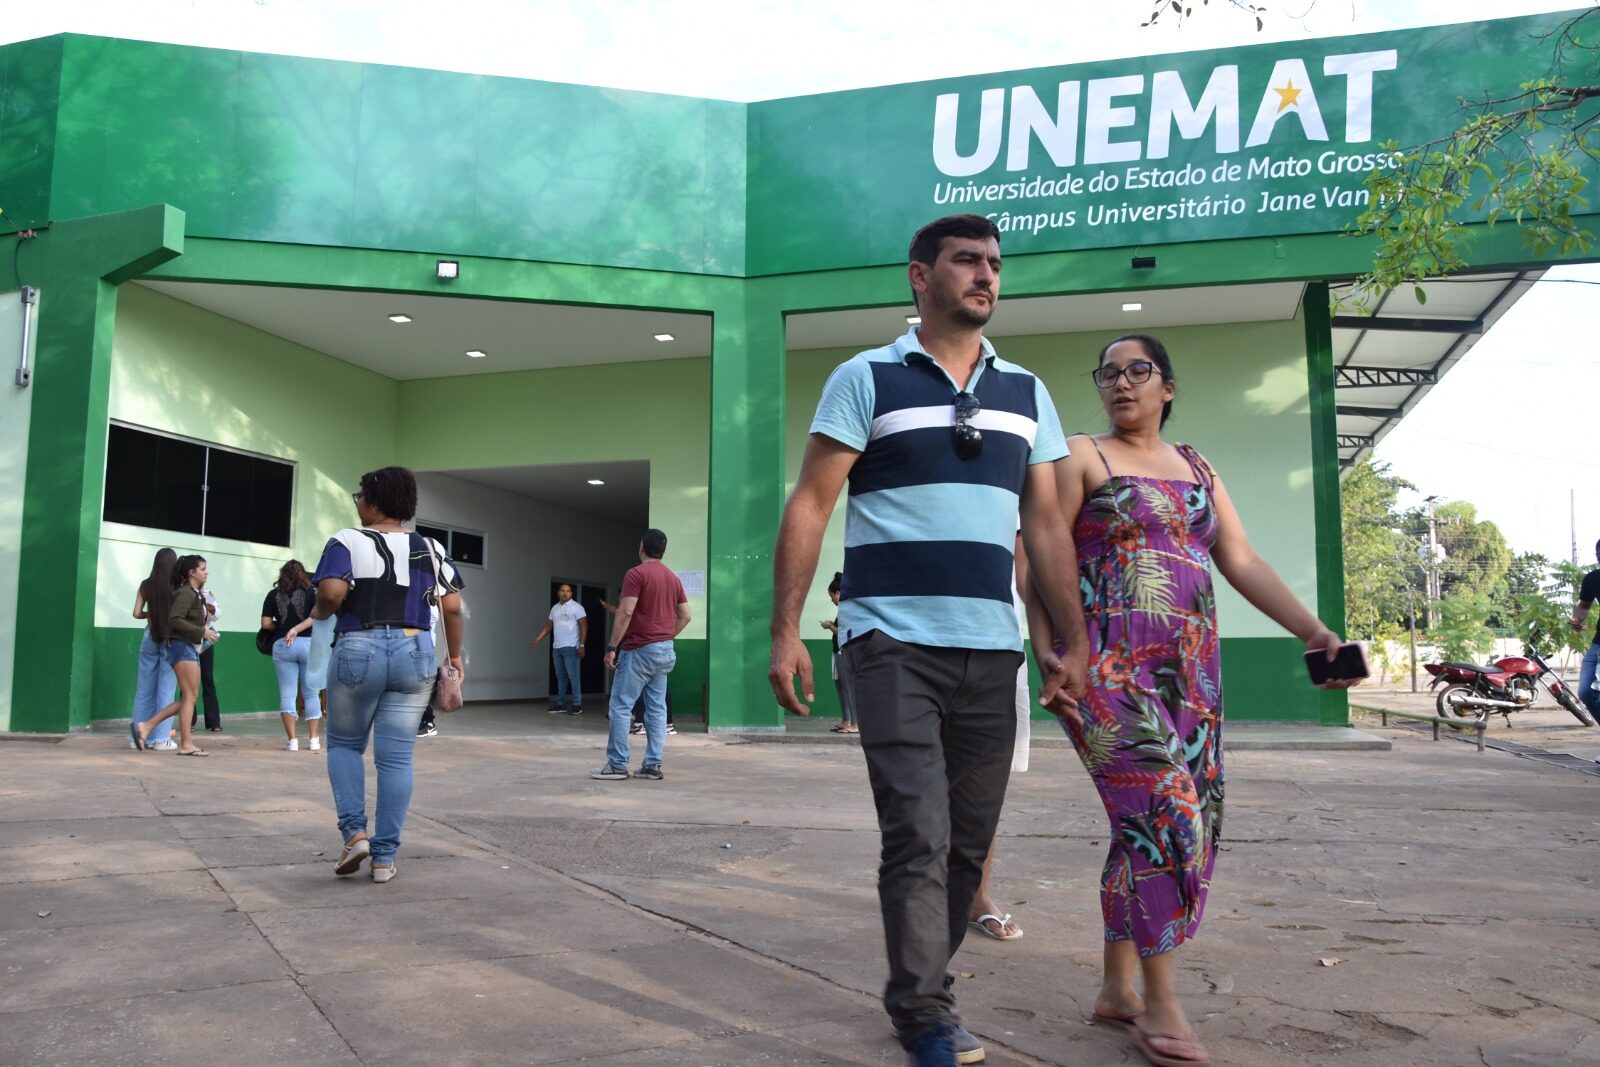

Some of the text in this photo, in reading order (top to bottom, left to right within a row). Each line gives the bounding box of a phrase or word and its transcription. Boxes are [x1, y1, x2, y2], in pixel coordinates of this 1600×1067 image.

[932, 48, 1399, 179] UNEMAT
[933, 174, 1085, 206] Universidade
[1088, 169, 1120, 193] do
[1123, 162, 1207, 190] Estado
[1211, 159, 1242, 183] de
[1246, 154, 1312, 182] Mato
[1086, 195, 1247, 226] Universitário
[1257, 190, 1317, 214] Jane
